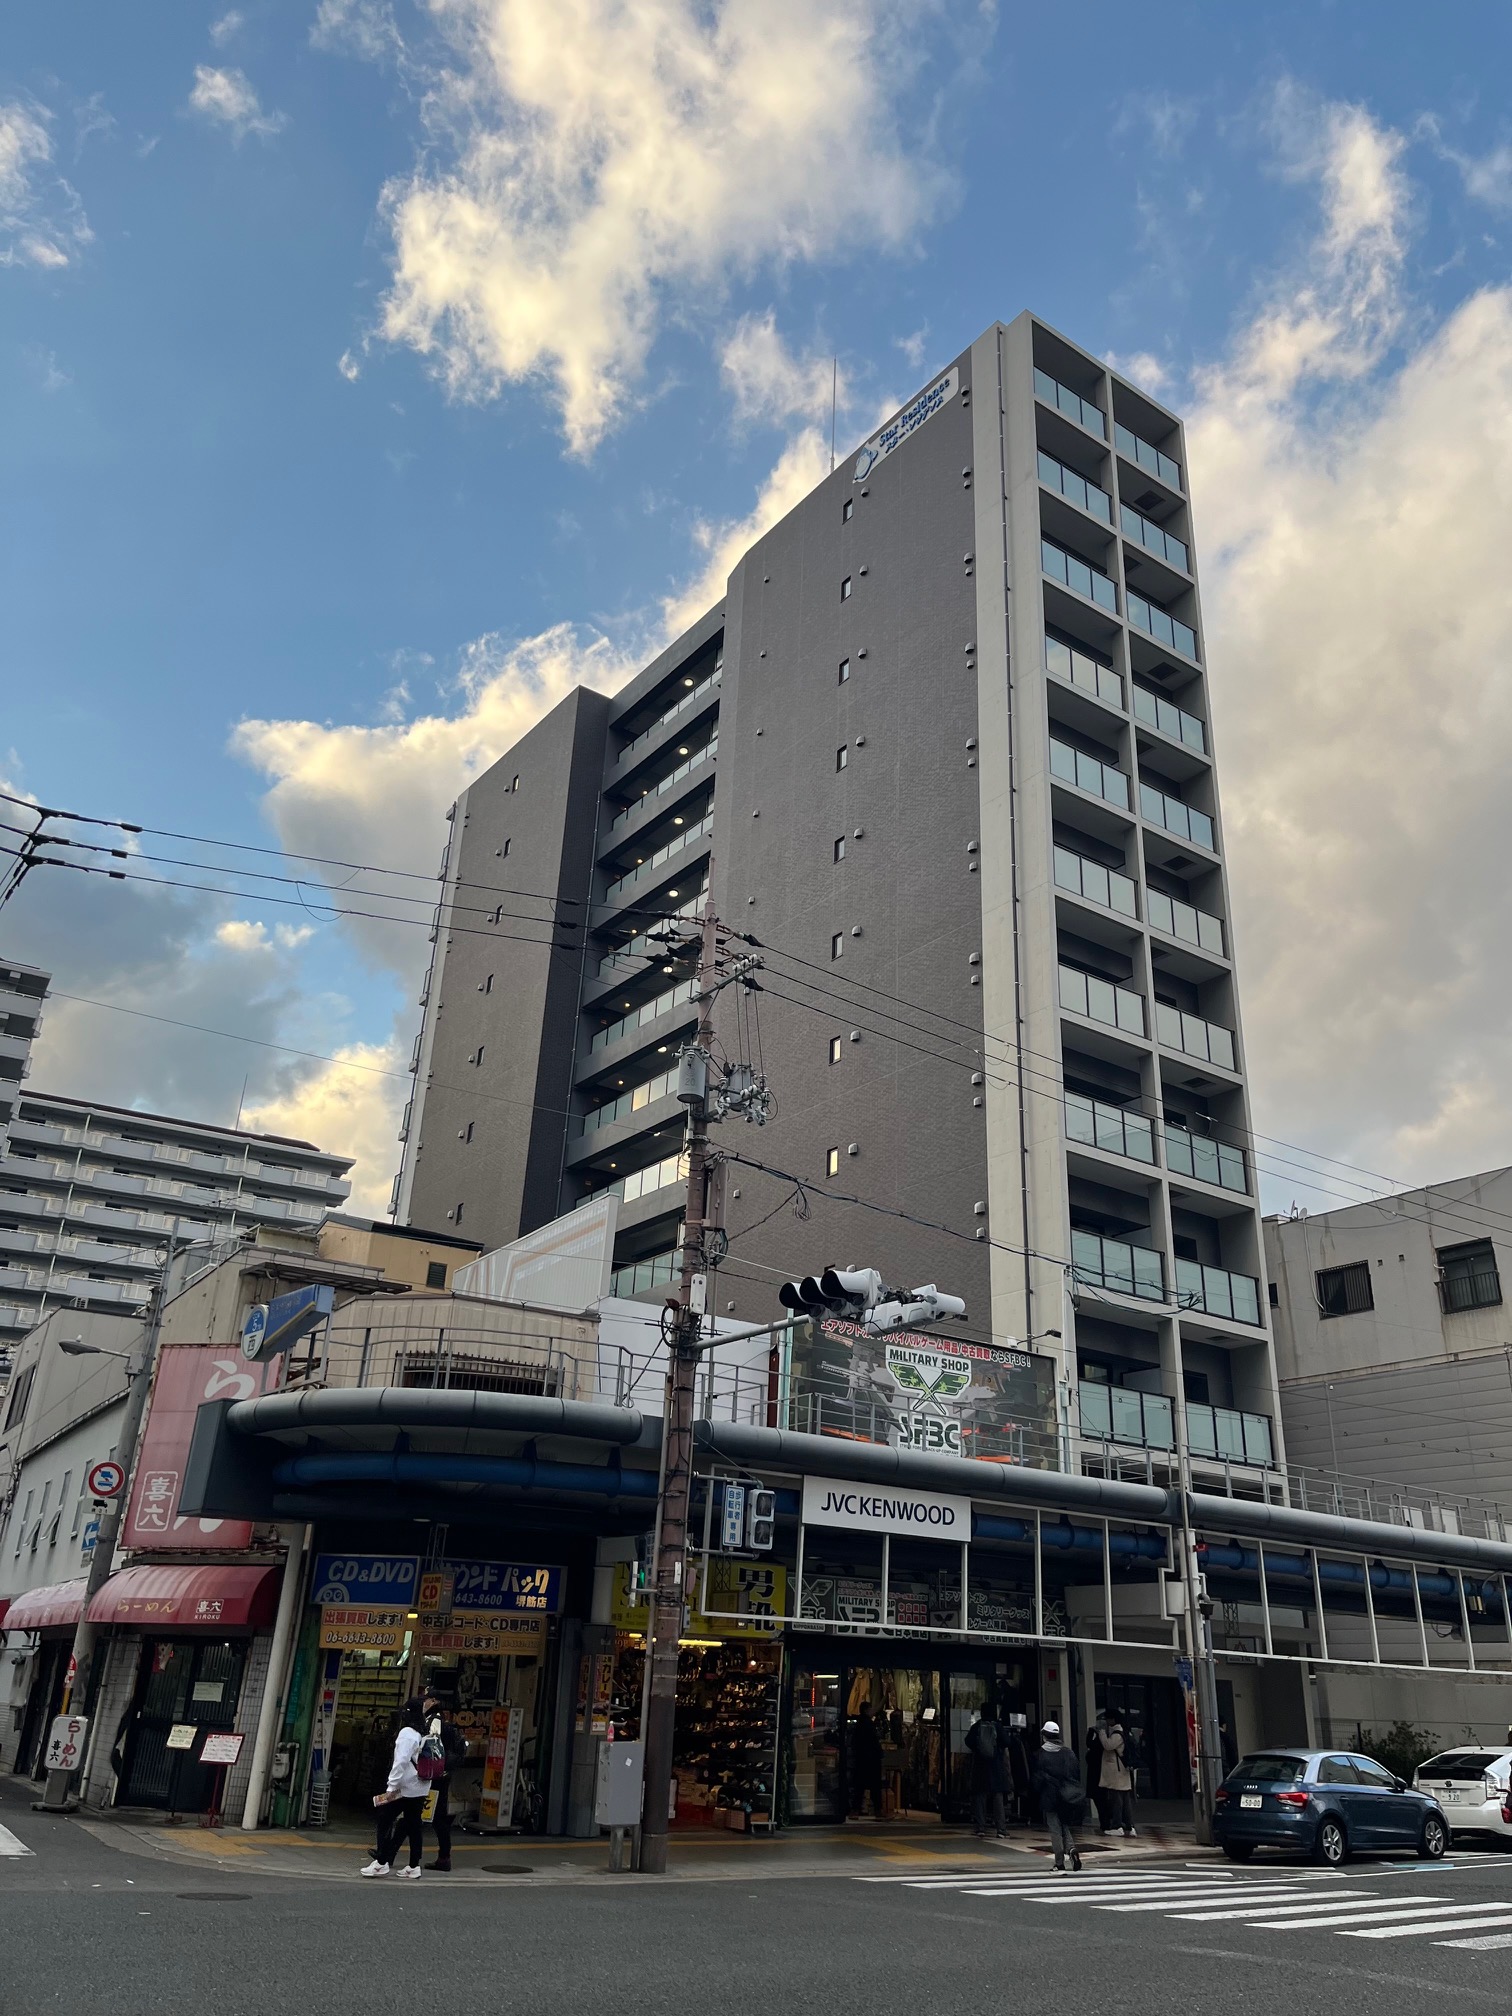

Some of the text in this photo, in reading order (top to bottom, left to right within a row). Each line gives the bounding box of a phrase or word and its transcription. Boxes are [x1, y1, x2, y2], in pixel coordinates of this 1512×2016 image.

[879, 378, 950, 447] Star Residence
[889, 1348, 969, 1372] MILITARY SHOP
[899, 1416, 959, 1450] SFBC
[139, 1477, 173, 1526] 喜六
[328, 1560, 415, 1583] CD&DVD
[422, 1584, 438, 1599] CD
[838, 1596, 896, 1608] MILITARY SOP
[117, 1599, 176, 1613] らーめん
[197, 1601, 222, 1612] 喜六
[325, 1631, 395, 1645] 06-6643-8600
[49, 1739, 62, 1761] 喜六
[59, 1720, 81, 1767] らーめん
